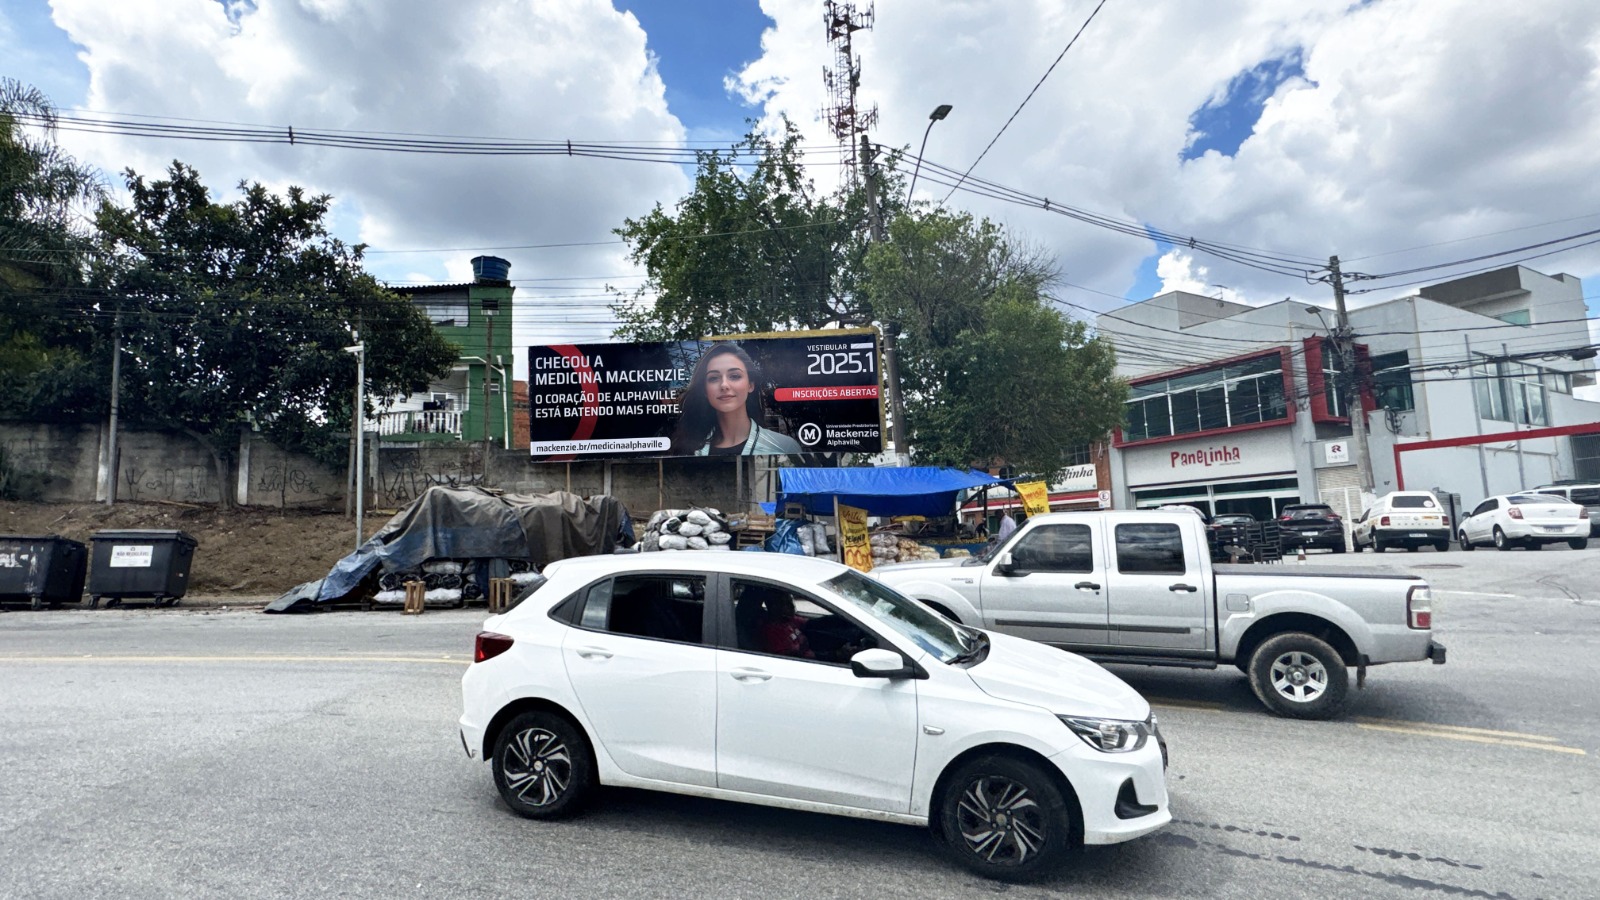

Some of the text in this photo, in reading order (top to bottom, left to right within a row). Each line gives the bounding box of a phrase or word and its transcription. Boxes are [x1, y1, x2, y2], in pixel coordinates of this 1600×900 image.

[807, 344, 848, 352] VESTIBULAR
[535, 355, 604, 370] CHEGOU A
[807, 352, 874, 375] 2025.1
[535, 368, 690, 385] MEDICINA MACKENZIE.
[535, 389, 677, 405] O CORAÇÃO DE ALPHAVILLE
[792, 388, 877, 399] INSCRIÇÕES ABERTAS
[535, 403, 683, 419] ESTÁ BATENDO MAIS FORTE.
[826, 429, 879, 438] Mackenzie
[536, 440, 663, 453] mackenzie.br/medicinaalphaville
